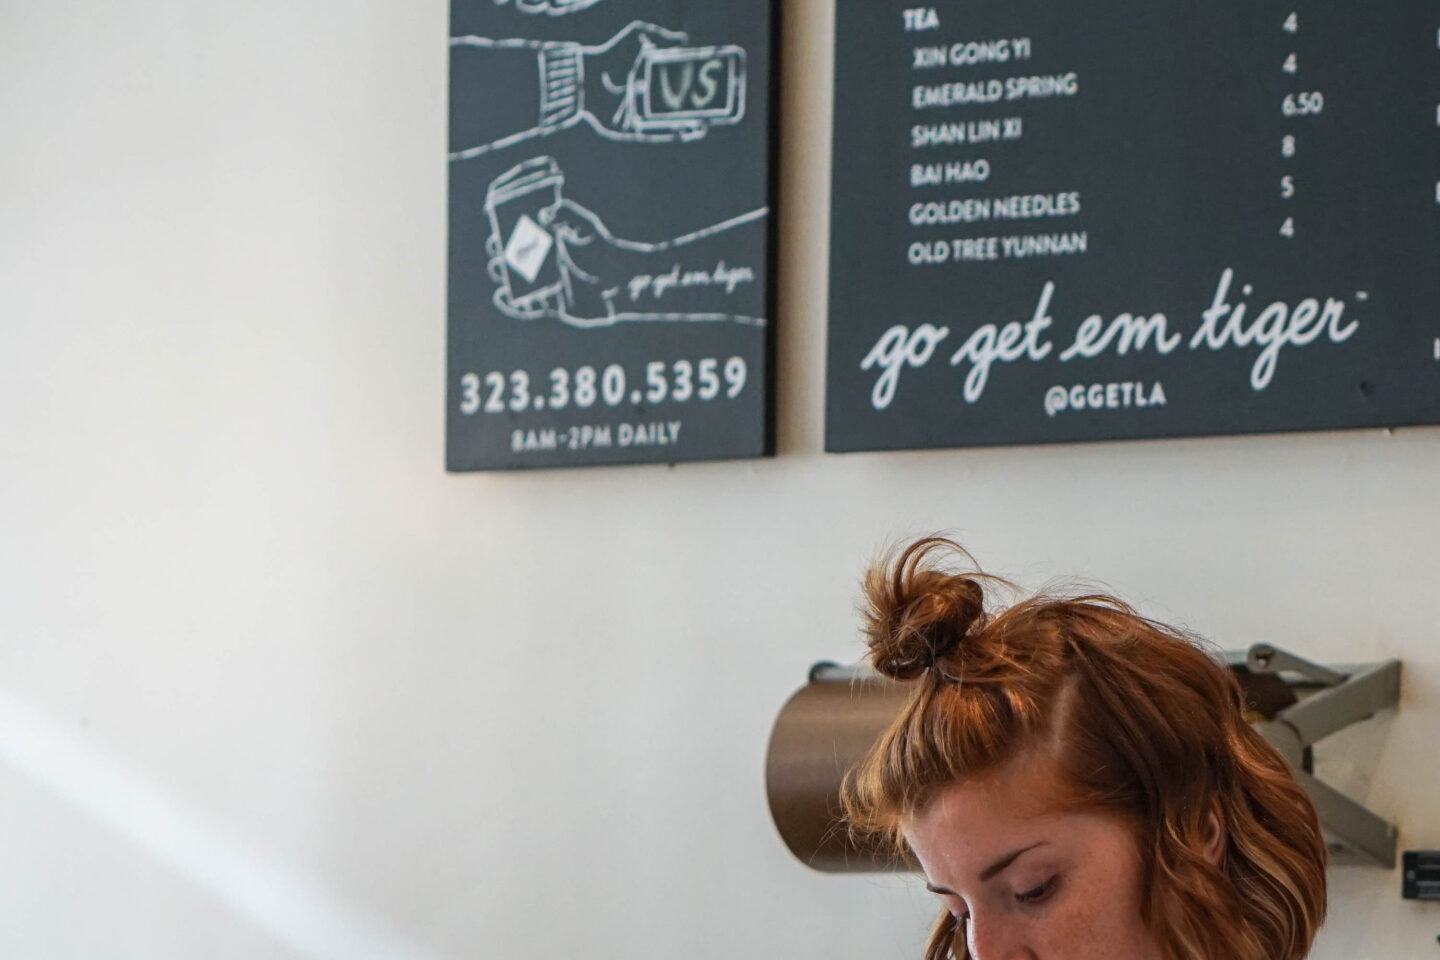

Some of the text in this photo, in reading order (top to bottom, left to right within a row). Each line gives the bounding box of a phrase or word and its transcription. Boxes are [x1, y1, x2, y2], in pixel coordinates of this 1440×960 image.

[904, 8, 939, 30] TEA
[1284, 13, 1297, 31] 4
[914, 38, 1030, 67] XIN GONG YI
[1283, 54, 1296, 72] 4
[913, 73, 1077, 108] EMERALD SPRING
[1282, 92, 1323, 115] 6.50
[912, 118, 1021, 147] SHAN LIN XI
[1282, 135, 1295, 156] 8
[911, 159, 989, 186] BAI HAO
[1281, 176, 1294, 198] 5
[909, 192, 1080, 225] GOLDEN NEEDLES
[1280, 218, 1294, 236] 4
[908, 232, 1087, 264] OLD TREE YUNNAN
[861, 268, 1358, 409] go get em tiger
[461, 357, 746, 414] 323.380.5359
[1045, 382, 1166, 416] @GGETLA
[511, 422, 680, 451] 8AM-2PM DAILY
